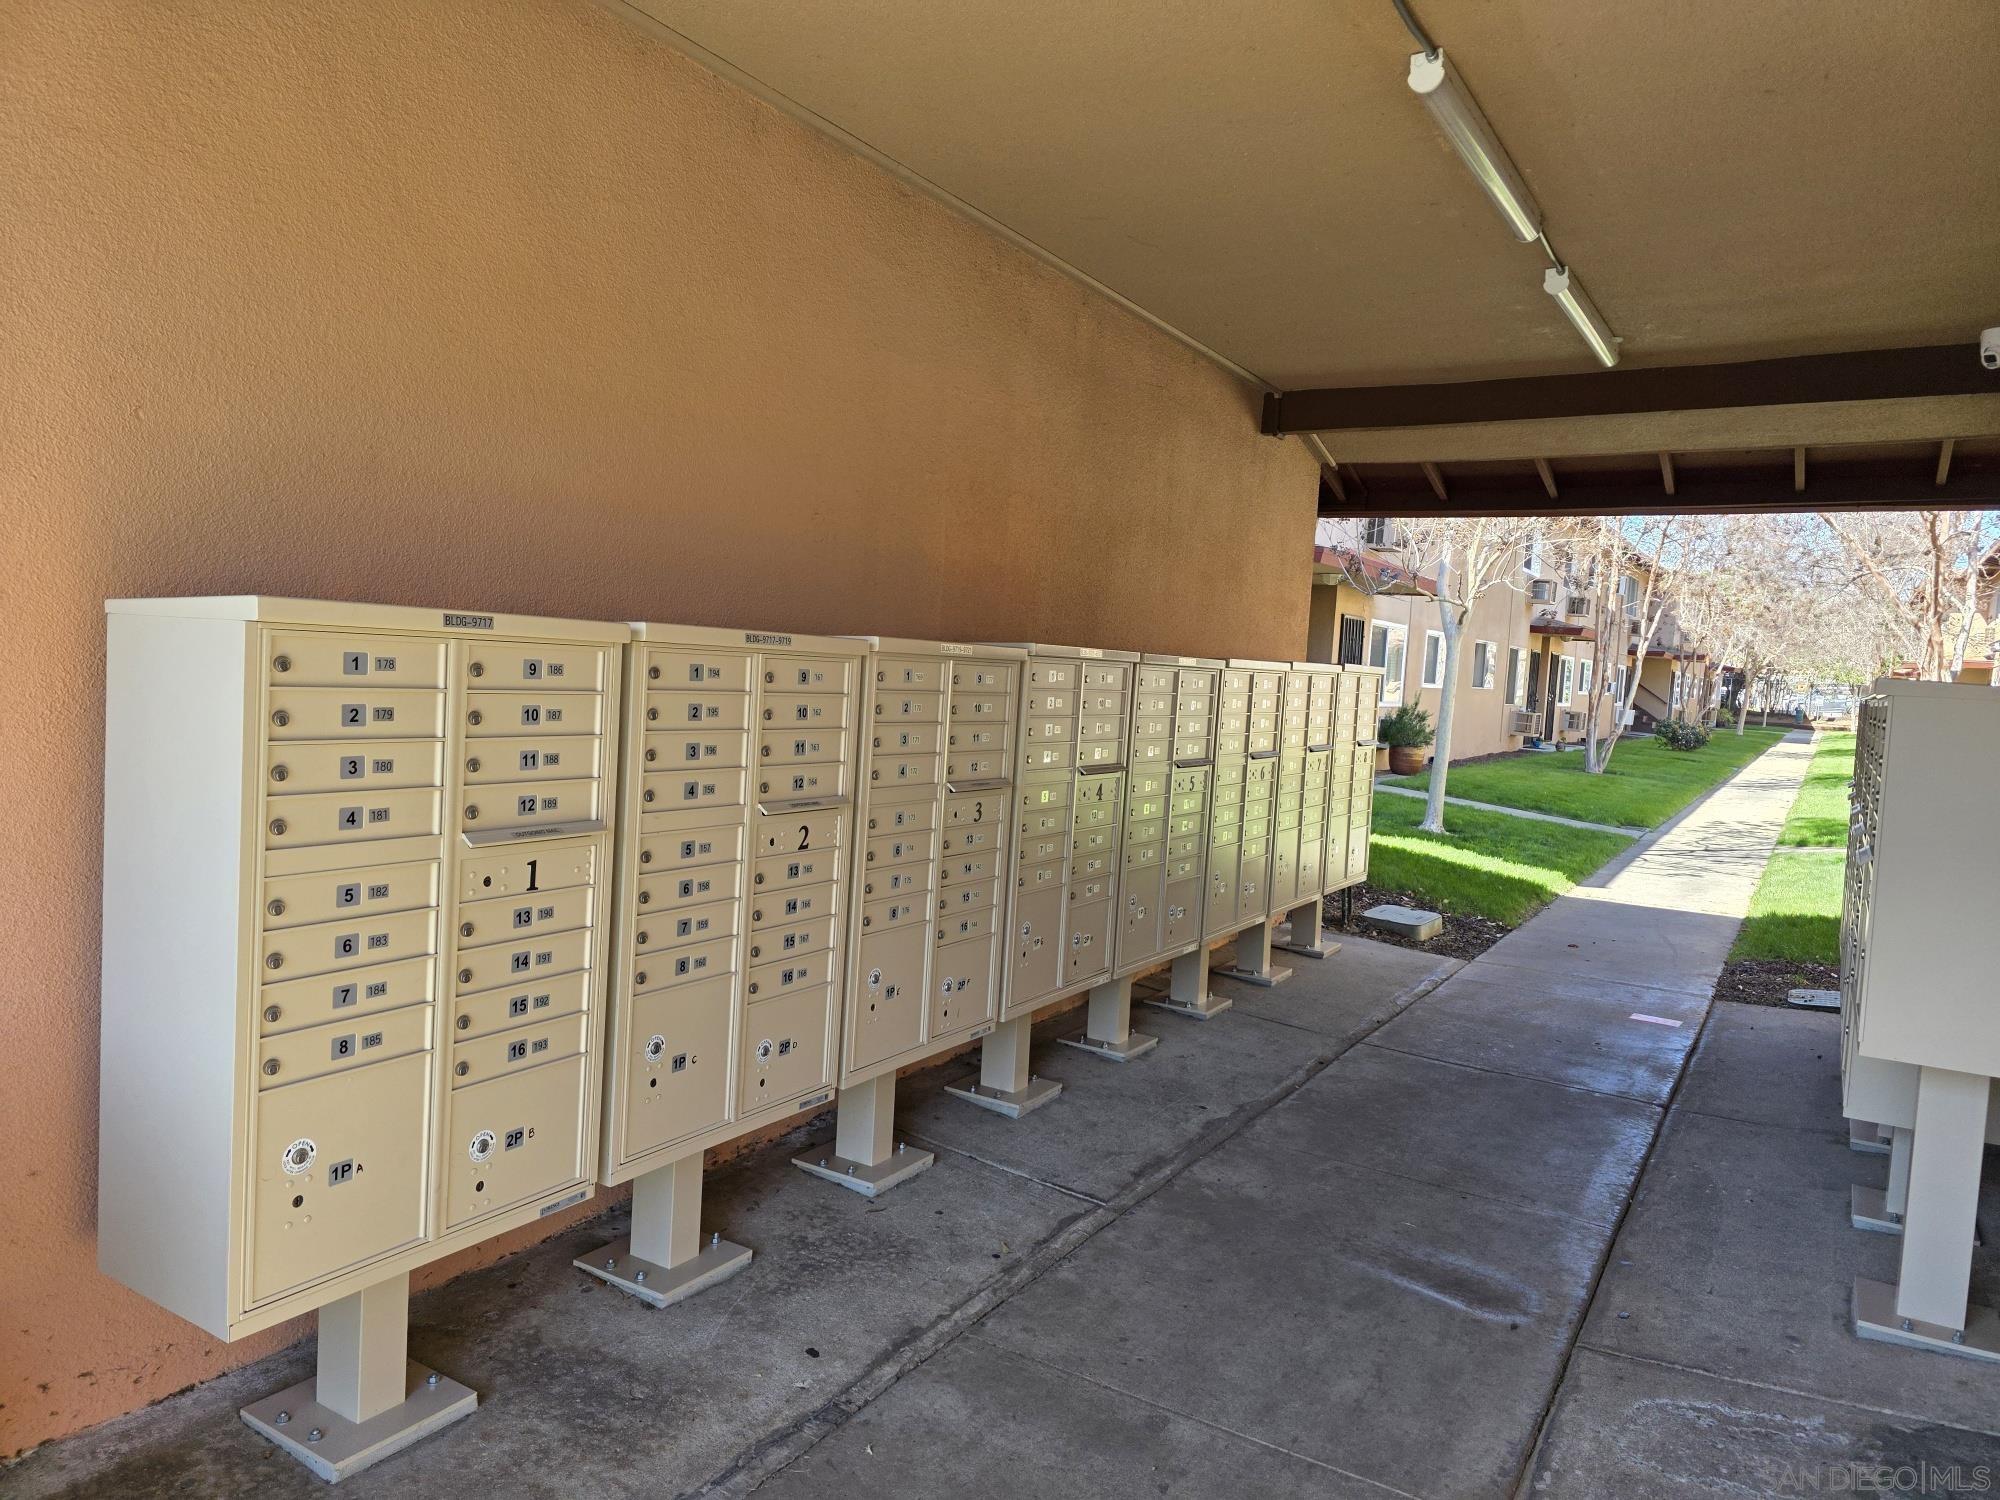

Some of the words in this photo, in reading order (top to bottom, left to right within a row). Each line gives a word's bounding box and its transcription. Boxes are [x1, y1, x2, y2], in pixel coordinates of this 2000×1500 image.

[445, 615, 493, 628] BLDG-9717
[352, 656, 359, 671] 1
[377, 659, 395, 670] 178
[529, 663, 537, 676] 9
[549, 665, 563, 674] 186
[692, 706, 698, 718] 2
[798, 708, 807, 718] 10
[975, 704, 981, 712] 10
[349, 709, 359, 722] 2
[375, 709, 393, 720] 179
[524, 708, 539, 722] 10
[547, 710, 561, 720] 187
[973, 734, 979, 742] 11
[690, 746, 696, 757] 3
[795, 743, 805, 753] 11
[522, 753, 536, 766] 11
[545, 755, 559, 764] 188
[348, 760, 358, 775] 3
[375, 761, 392, 771] 180
[971, 763, 978, 771] 12
[1260, 766, 1265, 779] 6
[793, 778, 804, 789] 12
[1189, 776, 1195, 791] 5
[688, 785, 695, 796] 4
[1096, 783, 1103, 800] 4
[520, 799, 535, 812] 12
[543, 799, 557, 808] 189
[974, 802, 982, 822] 3
[346, 811, 356, 825] 4
[371, 810, 387, 821] 181
[797, 825, 810, 850] 2
[967, 835, 973, 843] 13
[685, 844, 692, 855] 5
[789, 866, 799, 876] 13
[965, 864, 972, 872] 14
[526, 859, 539, 891] 1
[344, 888, 354, 903] 5
[370, 886, 388, 897] 182
[683, 883, 689, 894] 6
[963, 893, 970, 902] 15
[787, 902, 797, 912] 14
[516, 910, 531, 924] 13
[539, 909, 553, 919] 190
[681, 922, 688, 933] 7
[343, 938, 352, 953] 6
[371, 935, 387, 947] 183
[785, 936, 795, 947] 15
[514, 955, 529, 969] 14
[537, 953, 550, 964] 191
[680, 961, 686, 972] 8
[783, 971, 793, 982] 16
[341, 989, 350, 1003] 7
[368, 984, 385, 995] 184
[887, 987, 895, 997] 1P
[512, 999, 527, 1013] 15
[535, 996, 549, 1007] 192
[339, 1039, 349, 1054] 8
[364, 1034, 381, 1045] 185
[510, 1043, 526, 1057] 16
[534, 1039, 547, 1050] 193
[779, 1041, 790, 1054] 2P
[673, 1056, 686, 1069] 1P
[506, 1131, 523, 1147] 2P
[528, 1127, 535, 1138] B
[292, 1140, 310, 1149] OPEN
[331, 1163, 352, 1181] 1P
[356, 1163, 364, 1174] A
